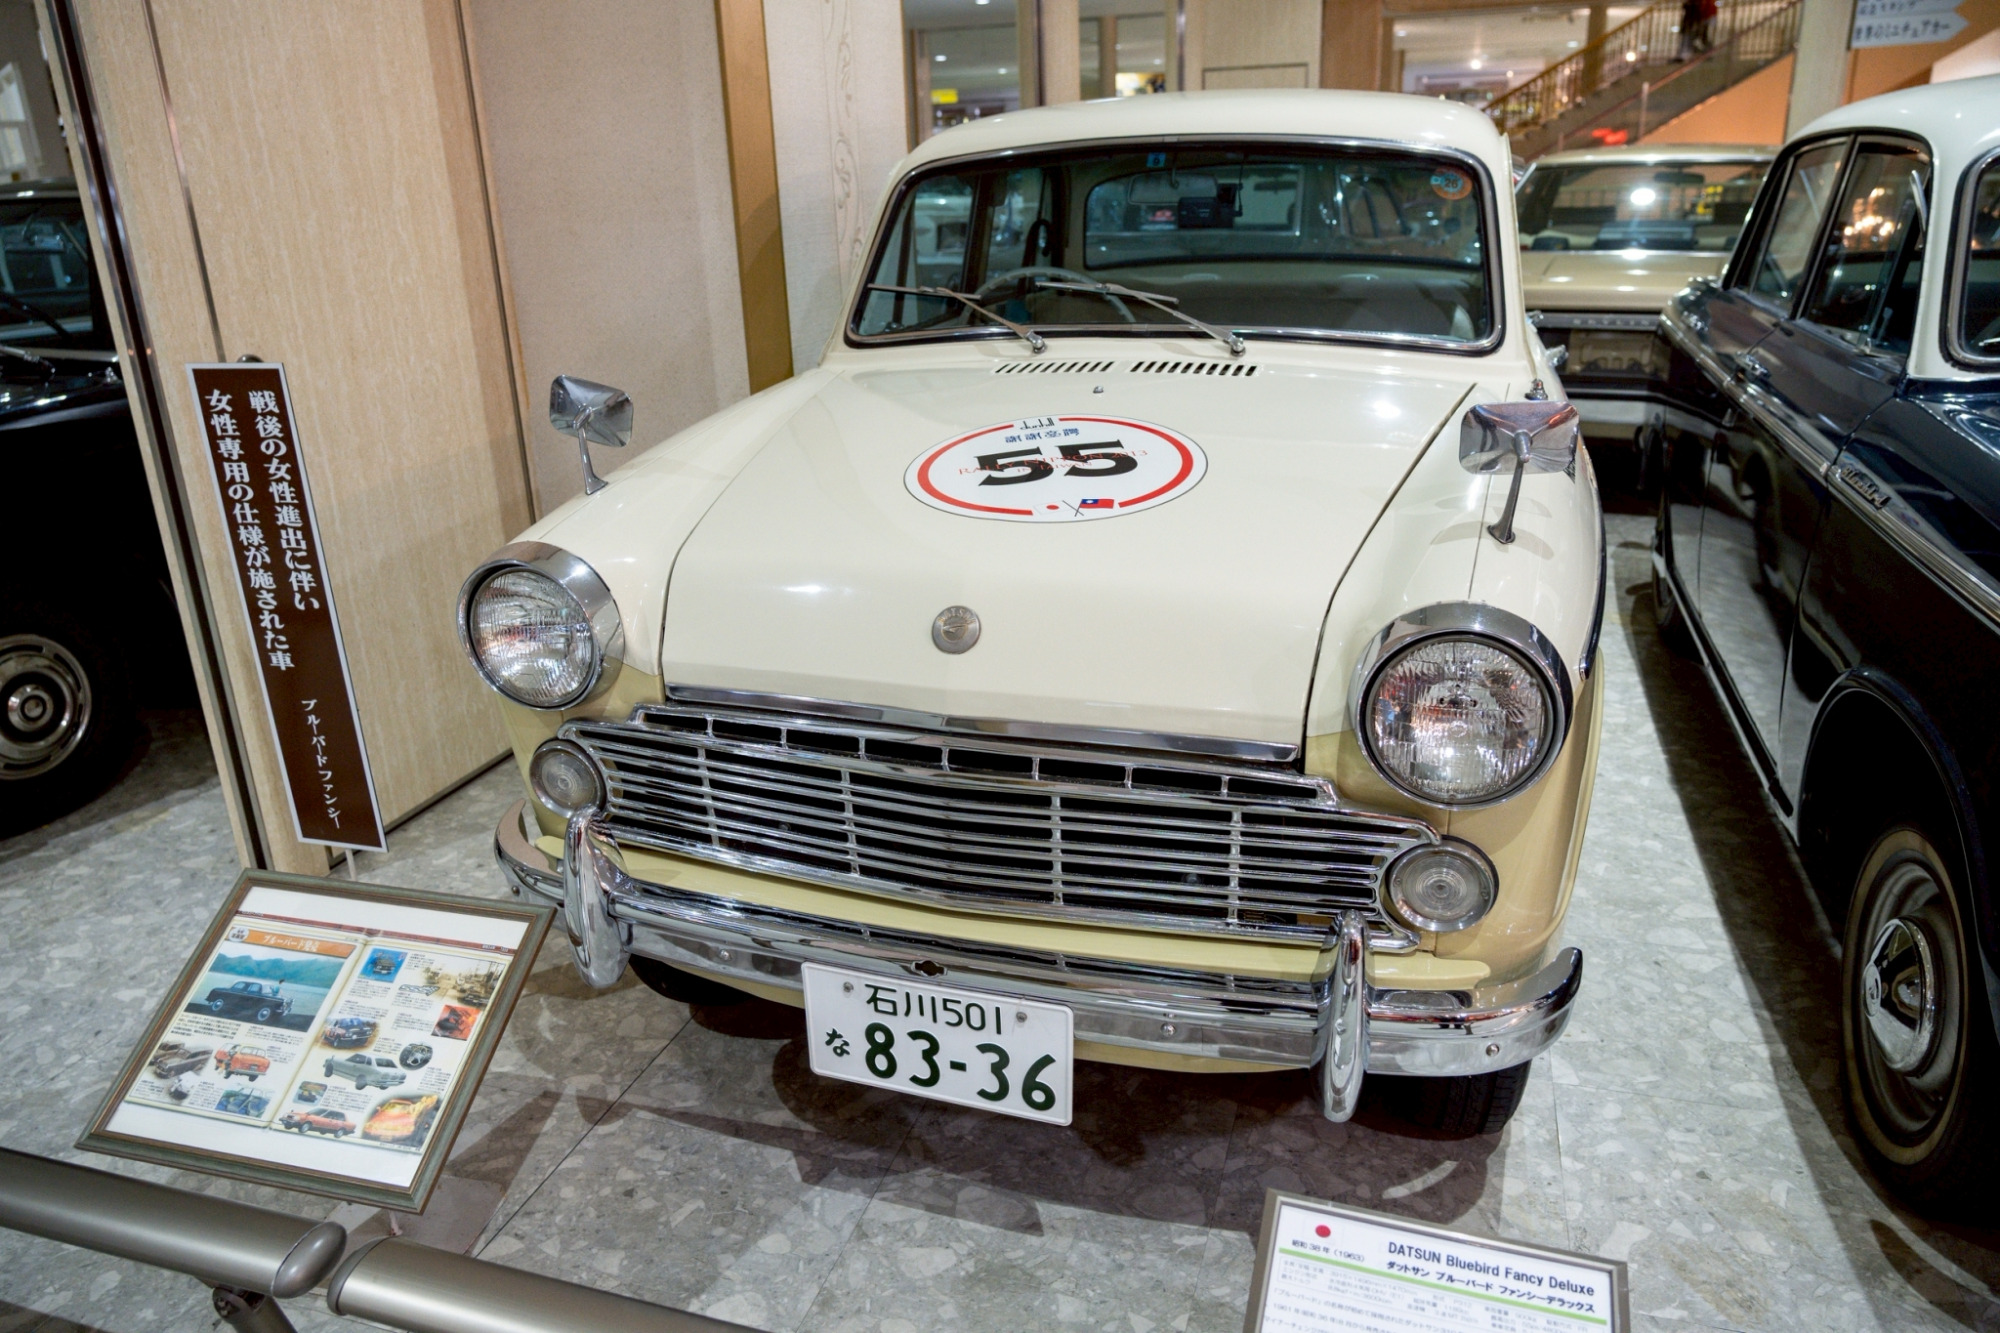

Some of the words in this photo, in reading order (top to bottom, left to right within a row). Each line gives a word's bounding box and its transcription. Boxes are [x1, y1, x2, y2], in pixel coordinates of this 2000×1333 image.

[1573, 317, 1650, 327] SKYLIN
[1019, 417, 1055, 430] dunhill
[974, 439, 1138, 486] 55
[1024, 452, 1104, 467] NIPPON
[248, 390, 320, 611] 戦後の女性進出に伴い
[205, 389, 295, 670] 女性専用の仕様が施された車
[301, 699, 341, 829] ブルーバードファンシー
[824, 1028, 851, 1057] な
[864, 1022, 1056, 1111] 83-36
[1387, 1260, 1431, 1277] ダットサン
[1436, 1271, 1493, 1291] ブルーバード
[1499, 1285, 1595, 1313] ファンシーデラックス
[1389, 1241, 1441, 1264] DATSUN
[1446, 1254, 1500, 1277] Bluebird
[1505, 1267, 1543, 1287] Fancy
[1550, 1276, 1595, 1296] Deluxe
